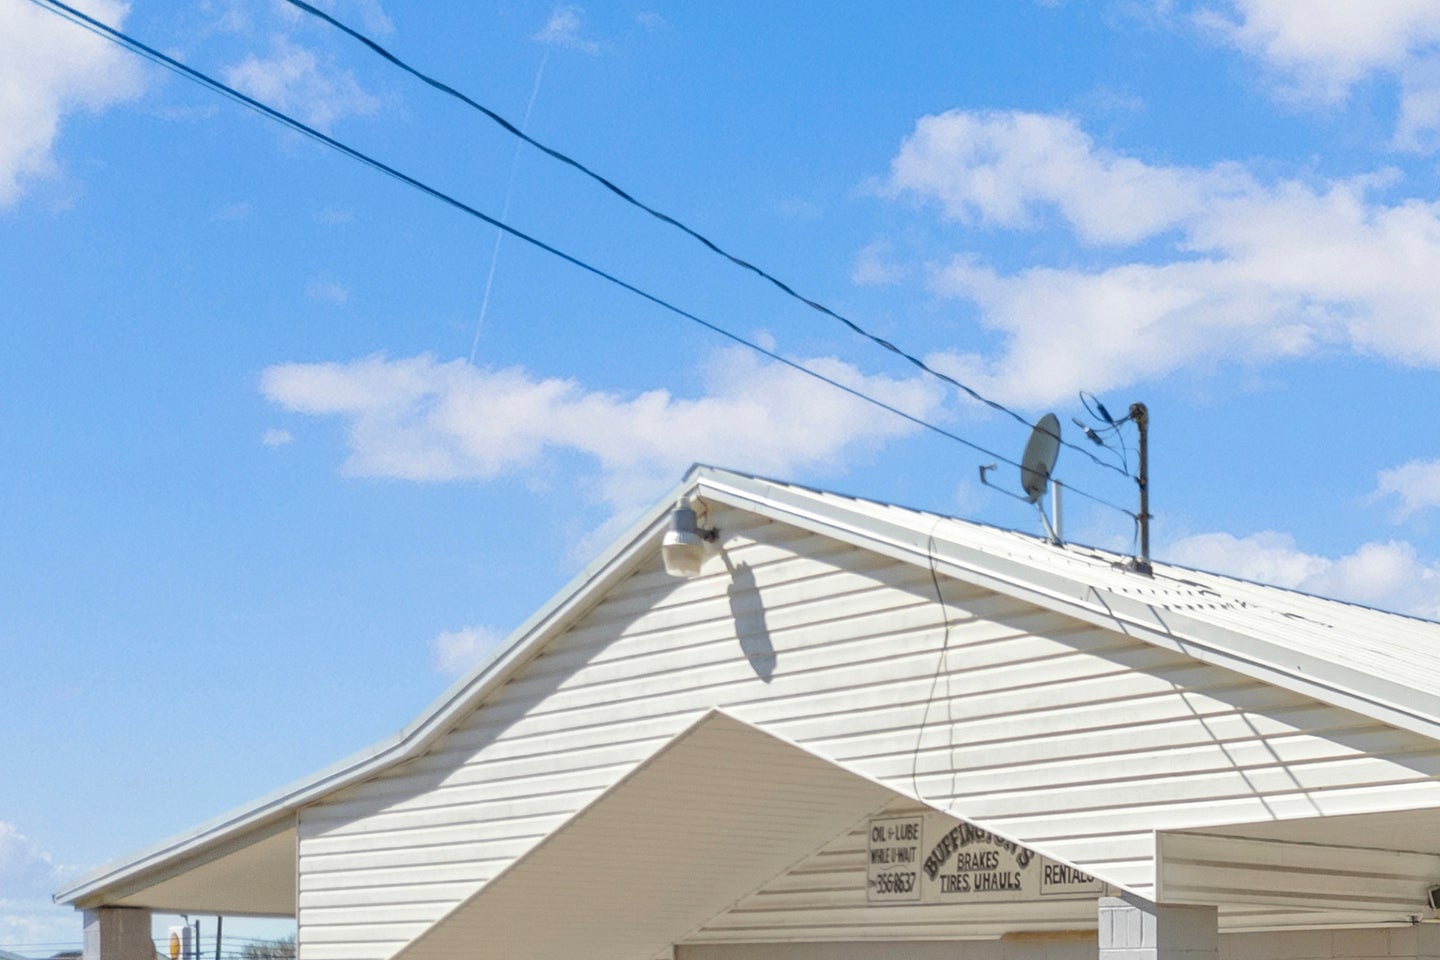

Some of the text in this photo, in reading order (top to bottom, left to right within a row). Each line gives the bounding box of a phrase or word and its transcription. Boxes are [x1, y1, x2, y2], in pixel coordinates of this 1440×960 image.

[872, 826, 886, 843] OIL
[895, 823, 919, 841] LUBE
[871, 848, 889, 864] WHILE
[957, 850, 1000, 870] BRAKES
[973, 871, 1022, 891] UHAULS
